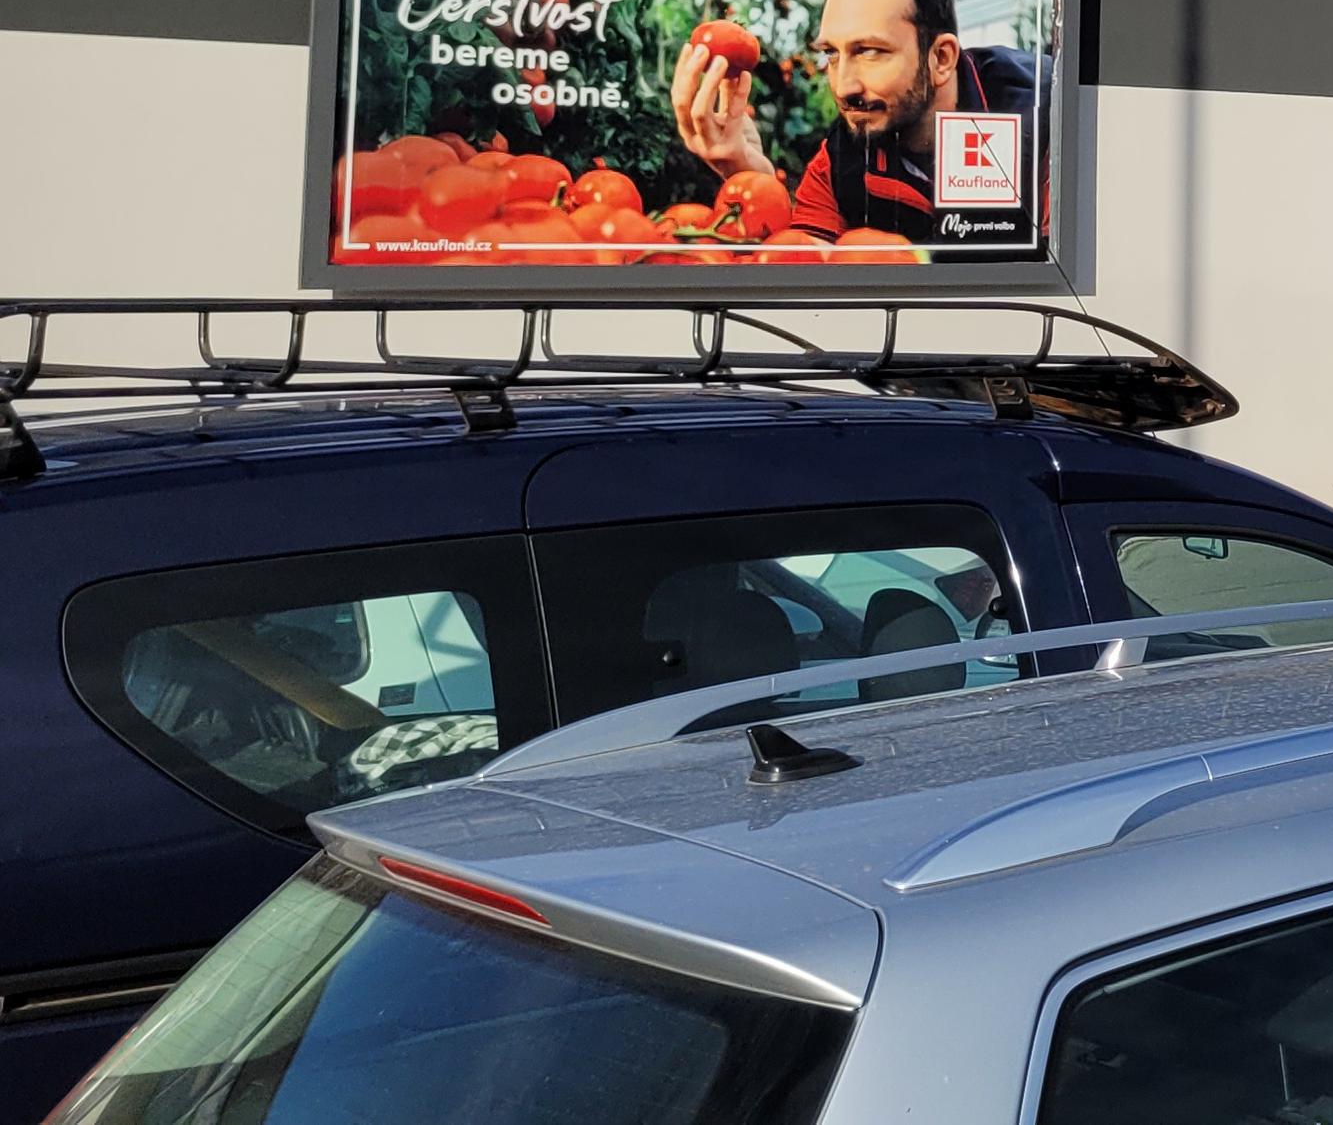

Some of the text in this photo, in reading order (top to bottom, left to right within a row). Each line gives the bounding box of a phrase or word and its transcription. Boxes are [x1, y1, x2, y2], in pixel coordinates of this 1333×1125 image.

[430, 34, 570, 72] bereme
[491, 79, 630, 109] osobně.
[947, 175, 1009, 188] Kaufland
[375, 238, 493, 252] www.kaufland.cz
